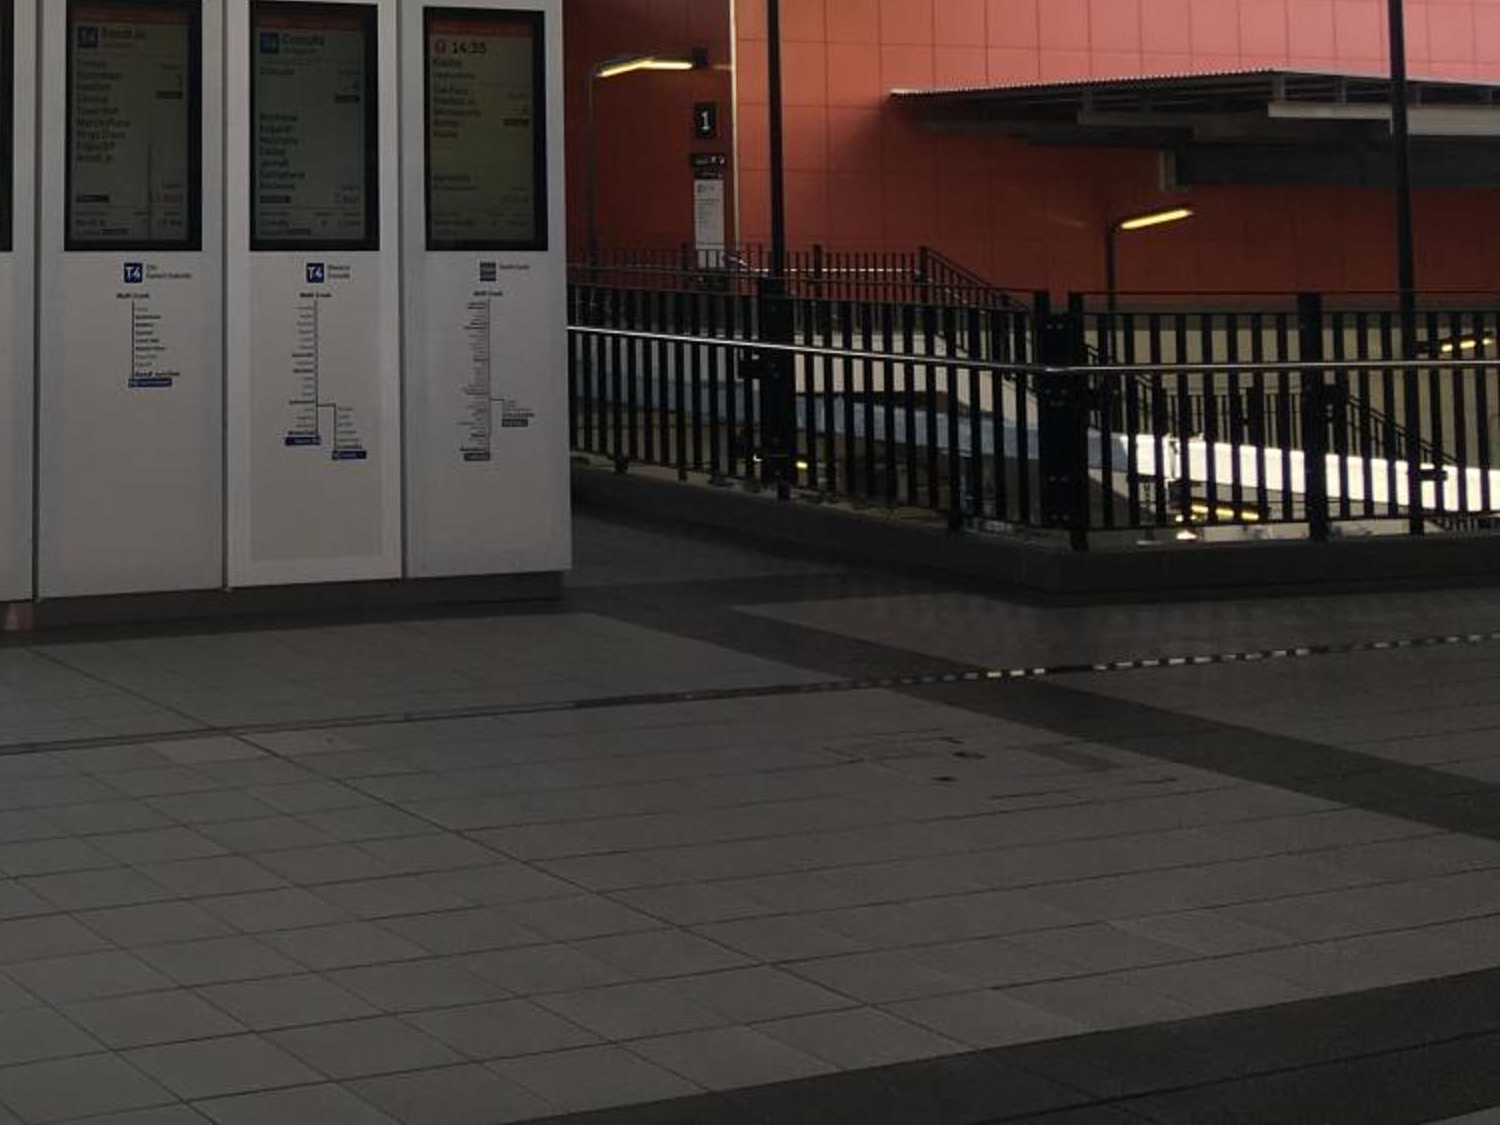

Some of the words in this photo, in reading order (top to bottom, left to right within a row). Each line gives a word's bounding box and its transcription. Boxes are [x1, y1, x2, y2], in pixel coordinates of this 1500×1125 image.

[700, 112, 711, 130] 1
[125, 266, 142, 279] T4
[307, 266, 323, 279] T4
